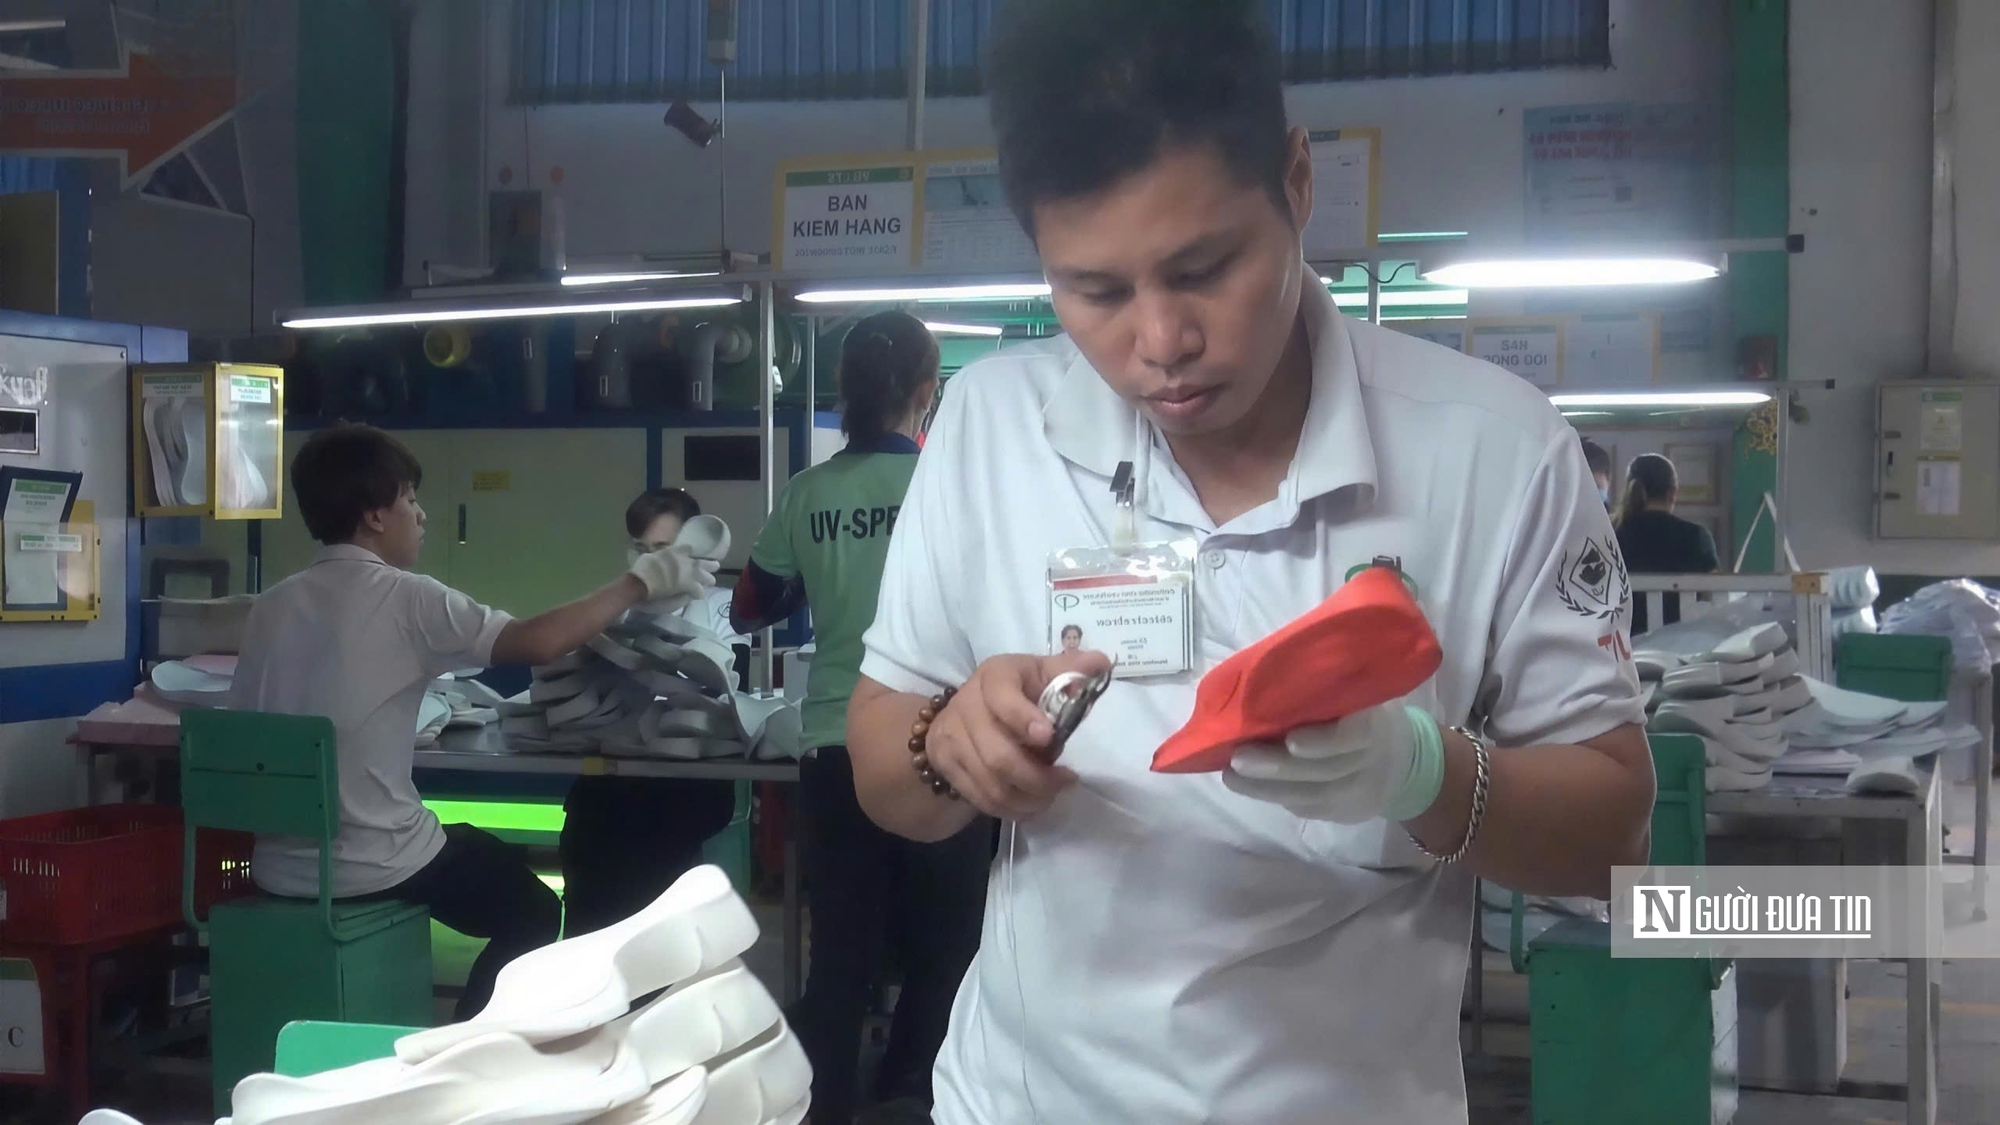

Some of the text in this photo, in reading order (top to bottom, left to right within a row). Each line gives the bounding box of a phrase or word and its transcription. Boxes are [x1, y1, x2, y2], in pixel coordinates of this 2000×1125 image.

[827, 194, 868, 212] BAN
[793, 217, 901, 238] KIEM HANG
[7, 1026, 24, 1048] C
